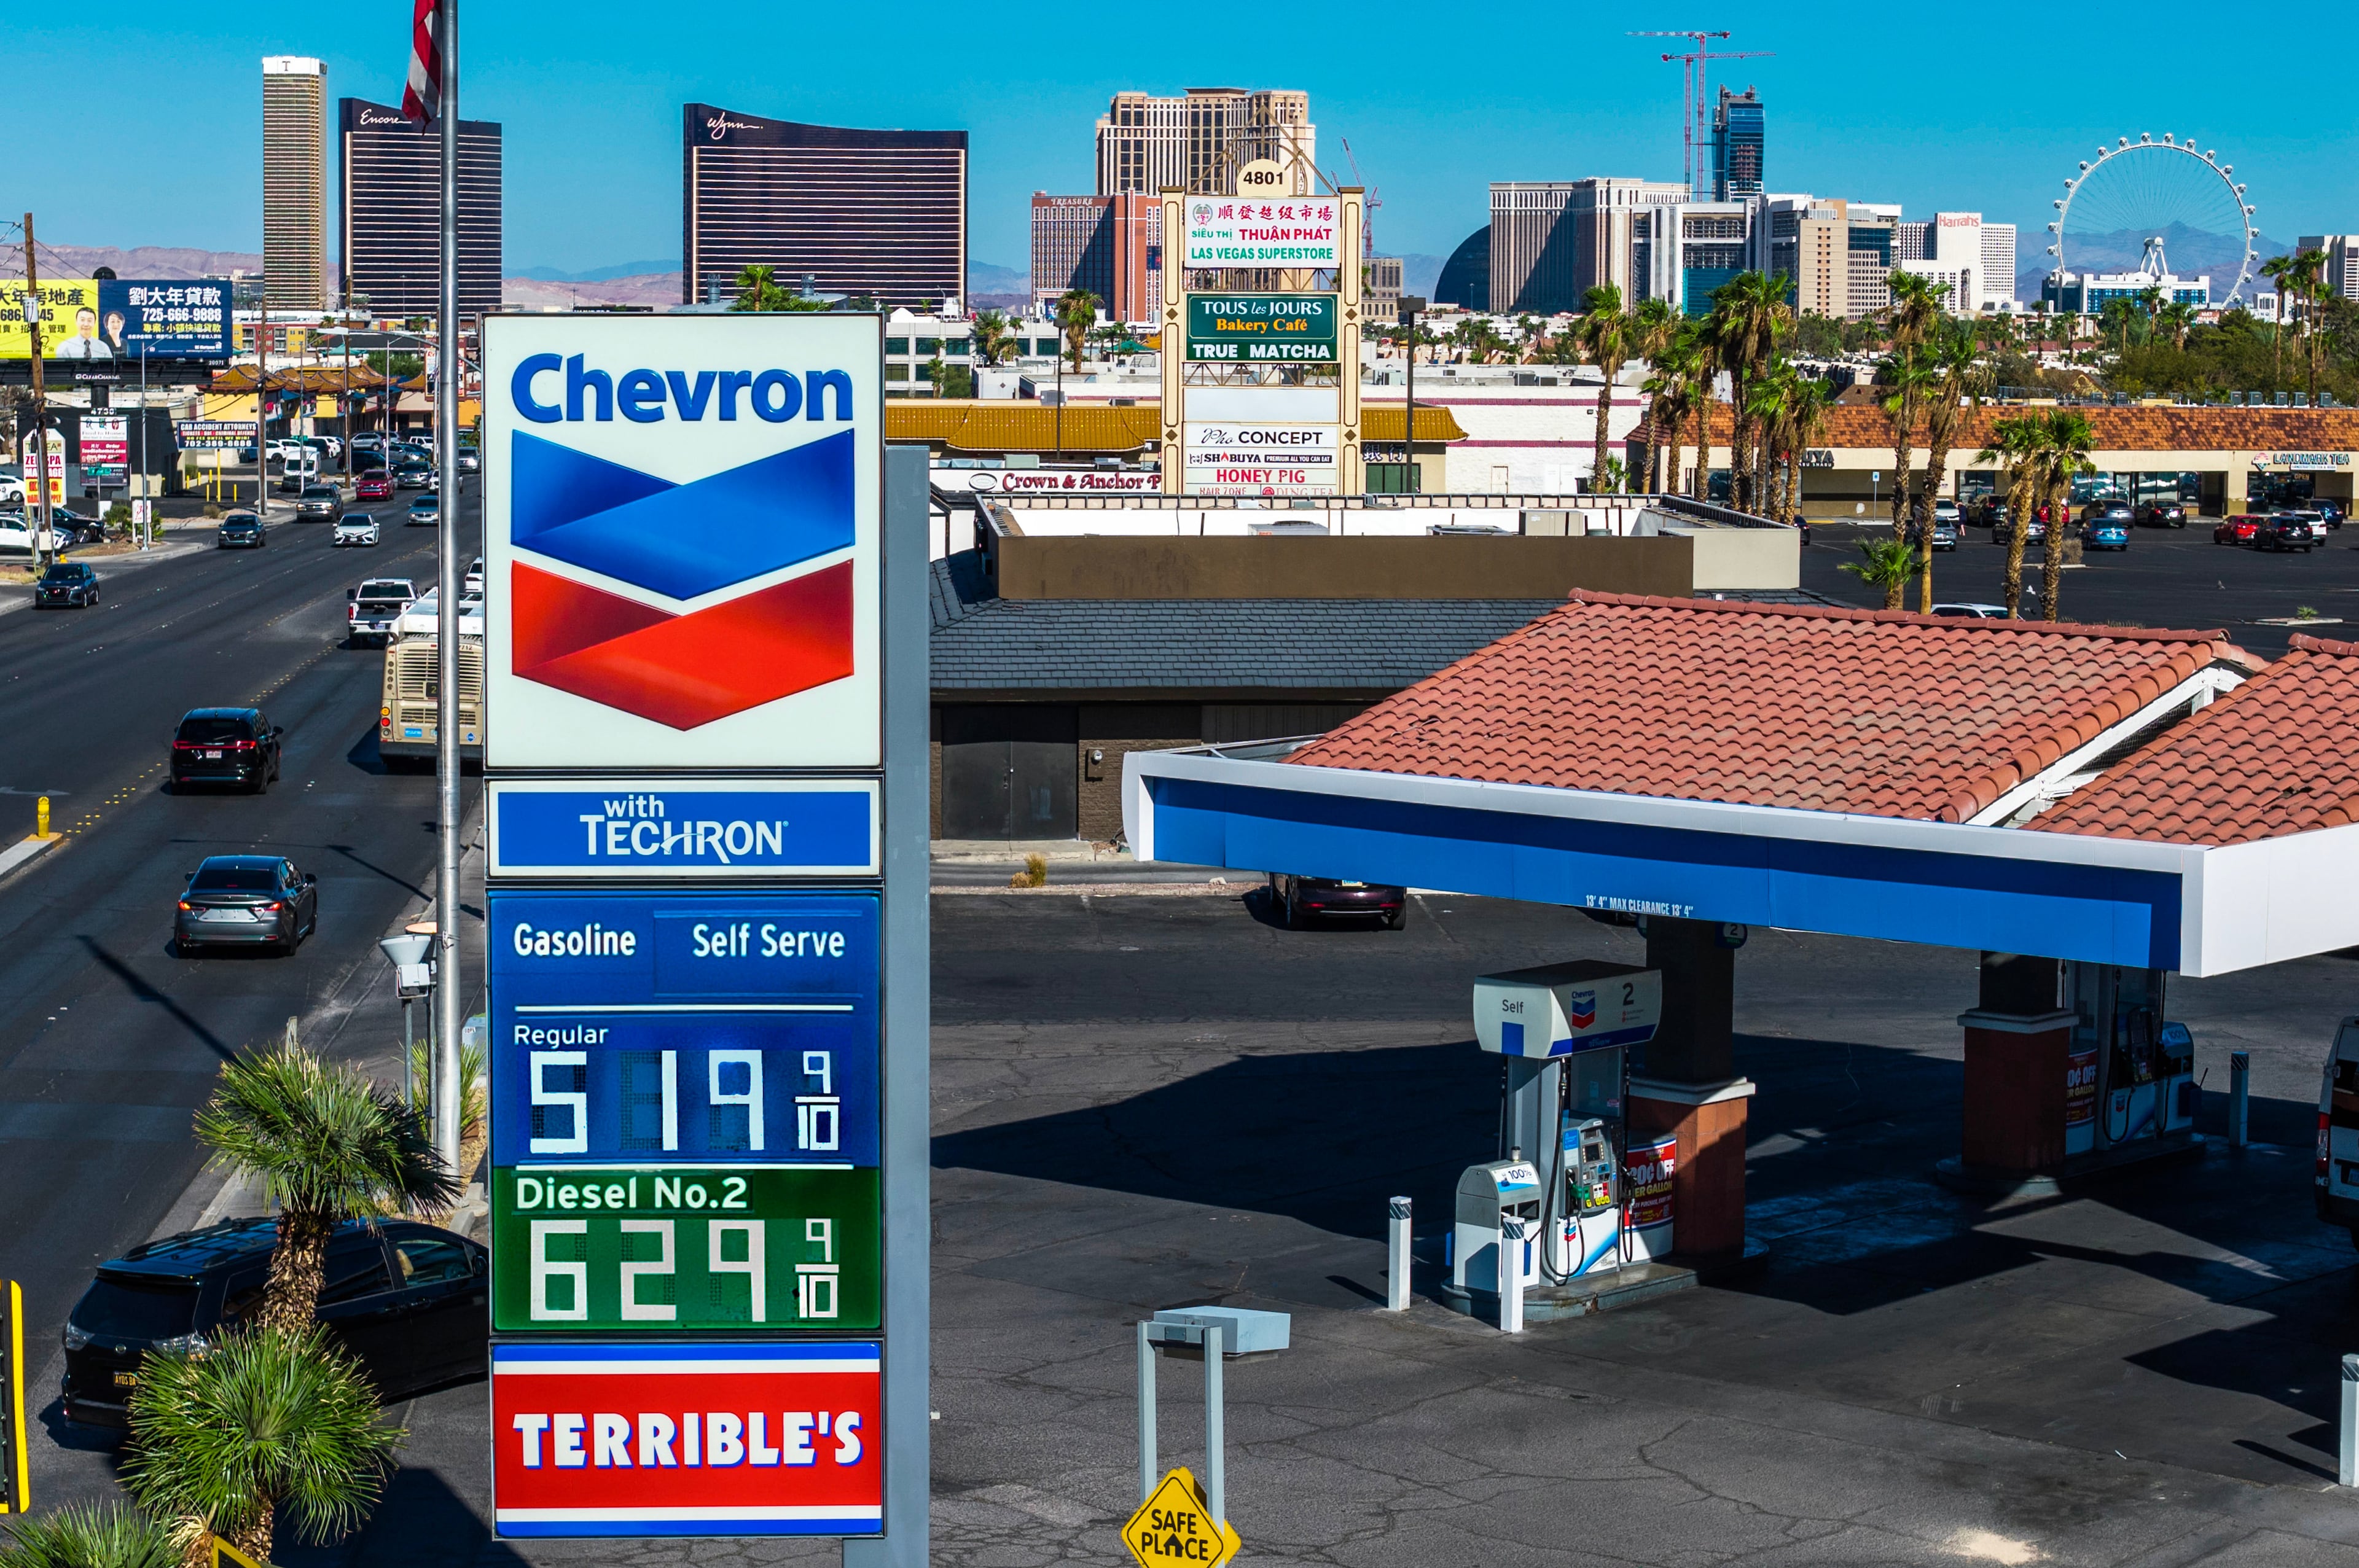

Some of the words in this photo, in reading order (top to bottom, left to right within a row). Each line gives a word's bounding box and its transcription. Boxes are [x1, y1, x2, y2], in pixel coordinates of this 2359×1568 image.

[359, 109, 412, 125] Encore
[1243, 171, 1284, 185] 4801
[1051, 197, 1093, 206] TREASURE
[1238, 225, 1291, 242] THUẬN
[1294, 225, 1332, 240] PHÁT
[1191, 248, 1213, 259] LAS
[1216, 248, 1255, 259] VEGAS
[1258, 248, 1333, 260] SUPERSTORE
[129, 287, 222, 306] 劉大年貸款
[0, 309, 53, 321] 686-45
[142, 308, 222, 322] 725-666-9888
[1201, 302, 1248, 315] TOUS
[1251, 301, 1267, 314] les
[1269, 302, 1323, 316] JOURS
[1216, 318, 1269, 333] Bakery
[1273, 318, 1308, 331] Café
[1192, 344, 1238, 358] TRUE
[1250, 344, 1331, 358] MATCHA
[511, 352, 854, 424] Chevron
[1201, 428, 1235, 444] Pho
[1238, 431, 1323, 445] CONCEPT
[1204, 450, 1261, 463] SHABUYA
[2273, 453, 2329, 465] LANDMARK
[2330, 453, 2351, 466] TEA
[1003, 472, 1059, 491] Crown
[1062, 474, 1077, 489] &
[1079, 472, 1145, 490] Anchor
[1216, 469, 1273, 483] HONEY
[1278, 469, 1305, 483] PIG
[29, 481, 59, 491] KG
[604, 795, 665, 817] with
[579, 815, 783, 864] TECHRON
[1610, 897, 1627, 911] MAX
[1628, 899, 1670, 915] CLEARANCE
[514, 923, 636, 957] Gasoline
[692, 923, 751, 958] Self
[761, 923, 845, 958] Serve
[1571, 989, 1595, 999] Chevron
[1622, 983, 1635, 1006] 2
[1502, 999, 1524, 1014] Self
[514, 1025, 609, 1049] Regular
[1508, 1169, 1532, 1180] 100%
[1656, 1158, 1675, 1181] OFF
[516, 1176, 637, 1209] Diesel
[655, 1176, 748, 1209] No.2
[1635, 1186, 1646, 1198] ER
[1646, 1180, 1673, 1195] GALLON
[512, 1410, 863, 1469] TERRIBLE'S
[1151, 1508, 1197, 1535] SAFE
